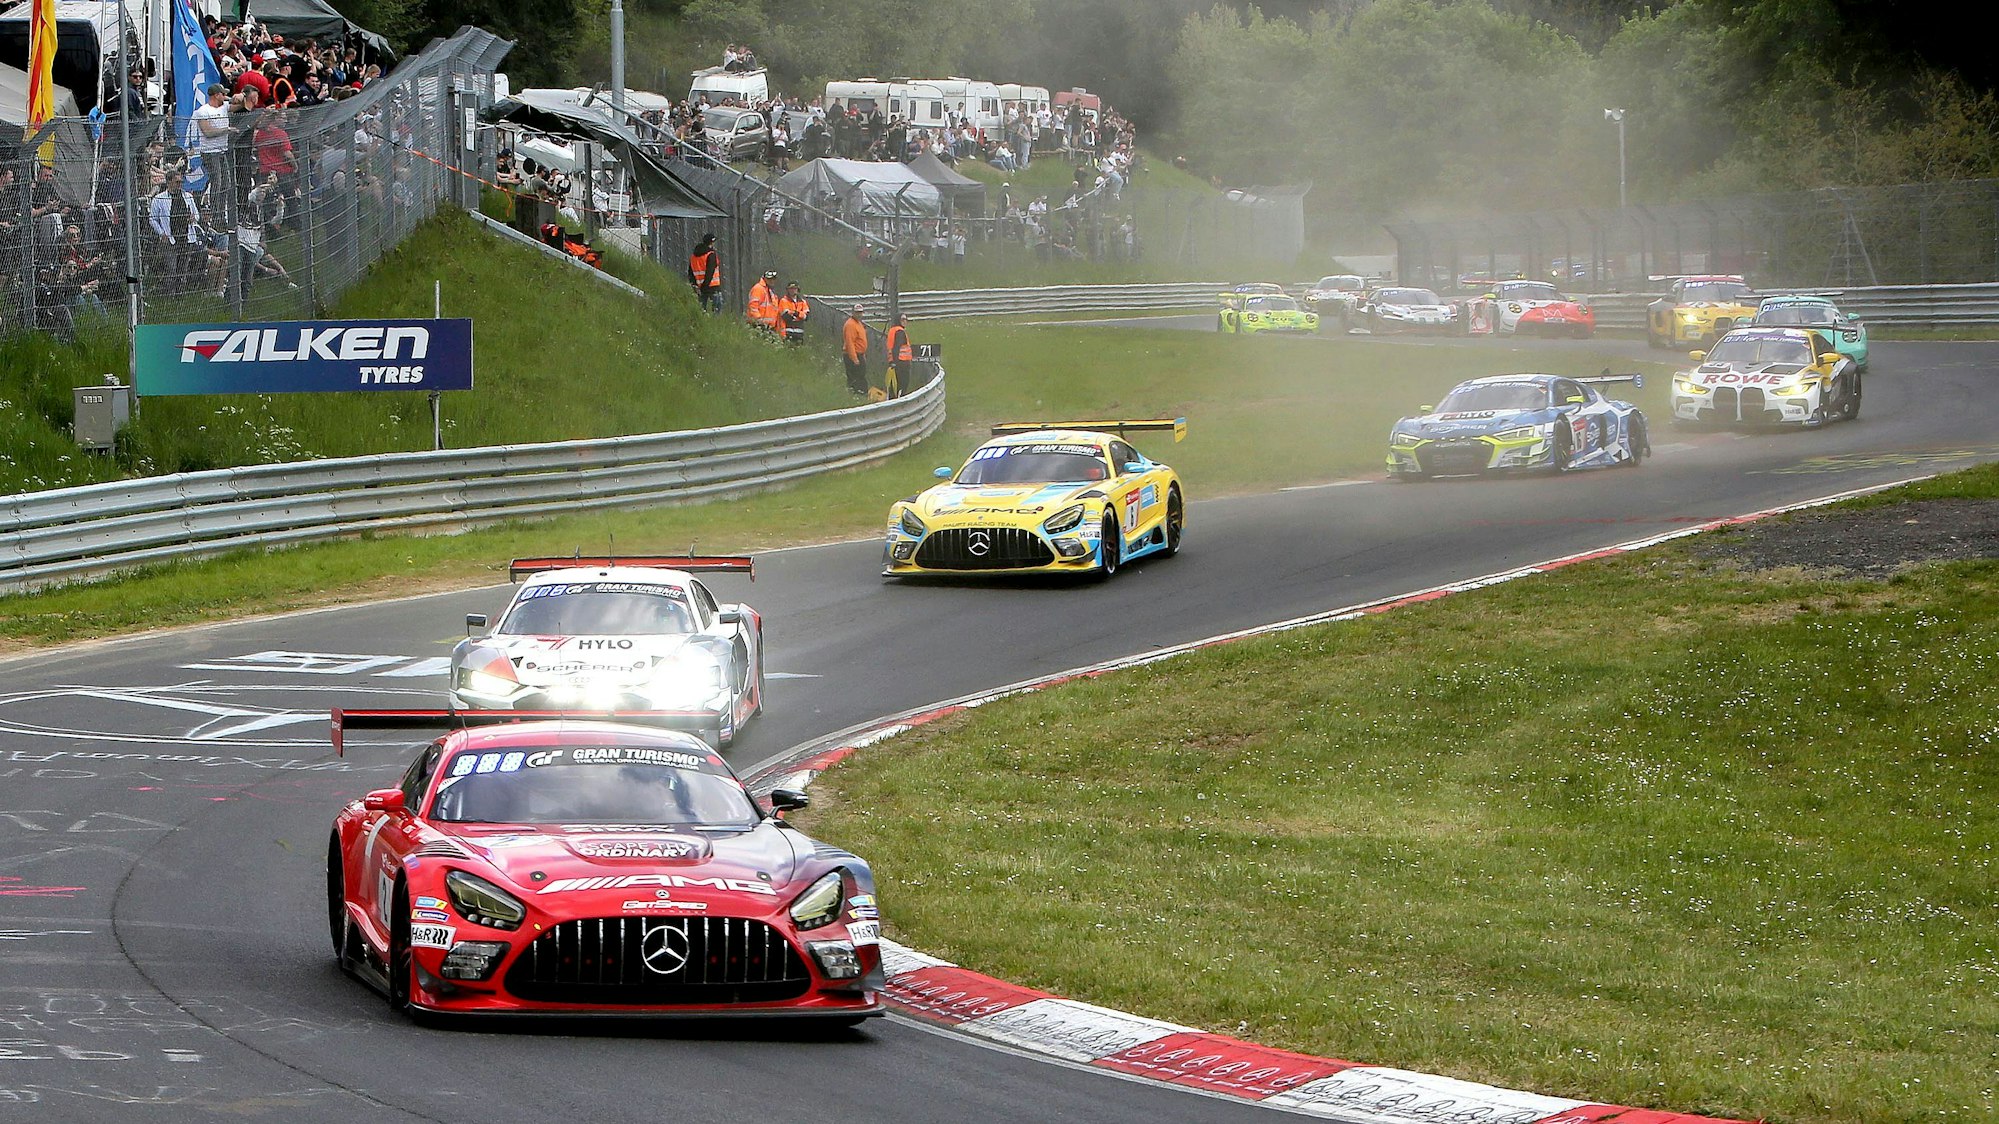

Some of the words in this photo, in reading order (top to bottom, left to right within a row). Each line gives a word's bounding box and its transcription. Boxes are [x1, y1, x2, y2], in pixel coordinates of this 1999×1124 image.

[179, 326, 430, 363] FALKEN
[920, 345, 932, 357] 71
[359, 366, 424, 384] TYRES
[1702, 373, 1785, 385] ROWE
[1032, 444, 1056, 452] GRAN
[1058, 445, 1097, 454] TURISMO
[596, 583, 628, 591] GRAN
[630, 584, 682, 597] TURISMO
[578, 639, 633, 650] HYLO
[536, 664, 633, 673] SCHERER
[572, 748, 621, 761] GRAN
[624, 749, 700, 766] TURISMO
[652, 761, 700, 771] SIMULATOR
[577, 841, 651, 850] ESCAPE
[579, 848, 693, 859] ORDINARY
[615, 874, 777, 896] AMG
[411, 926, 432, 941] H&R
